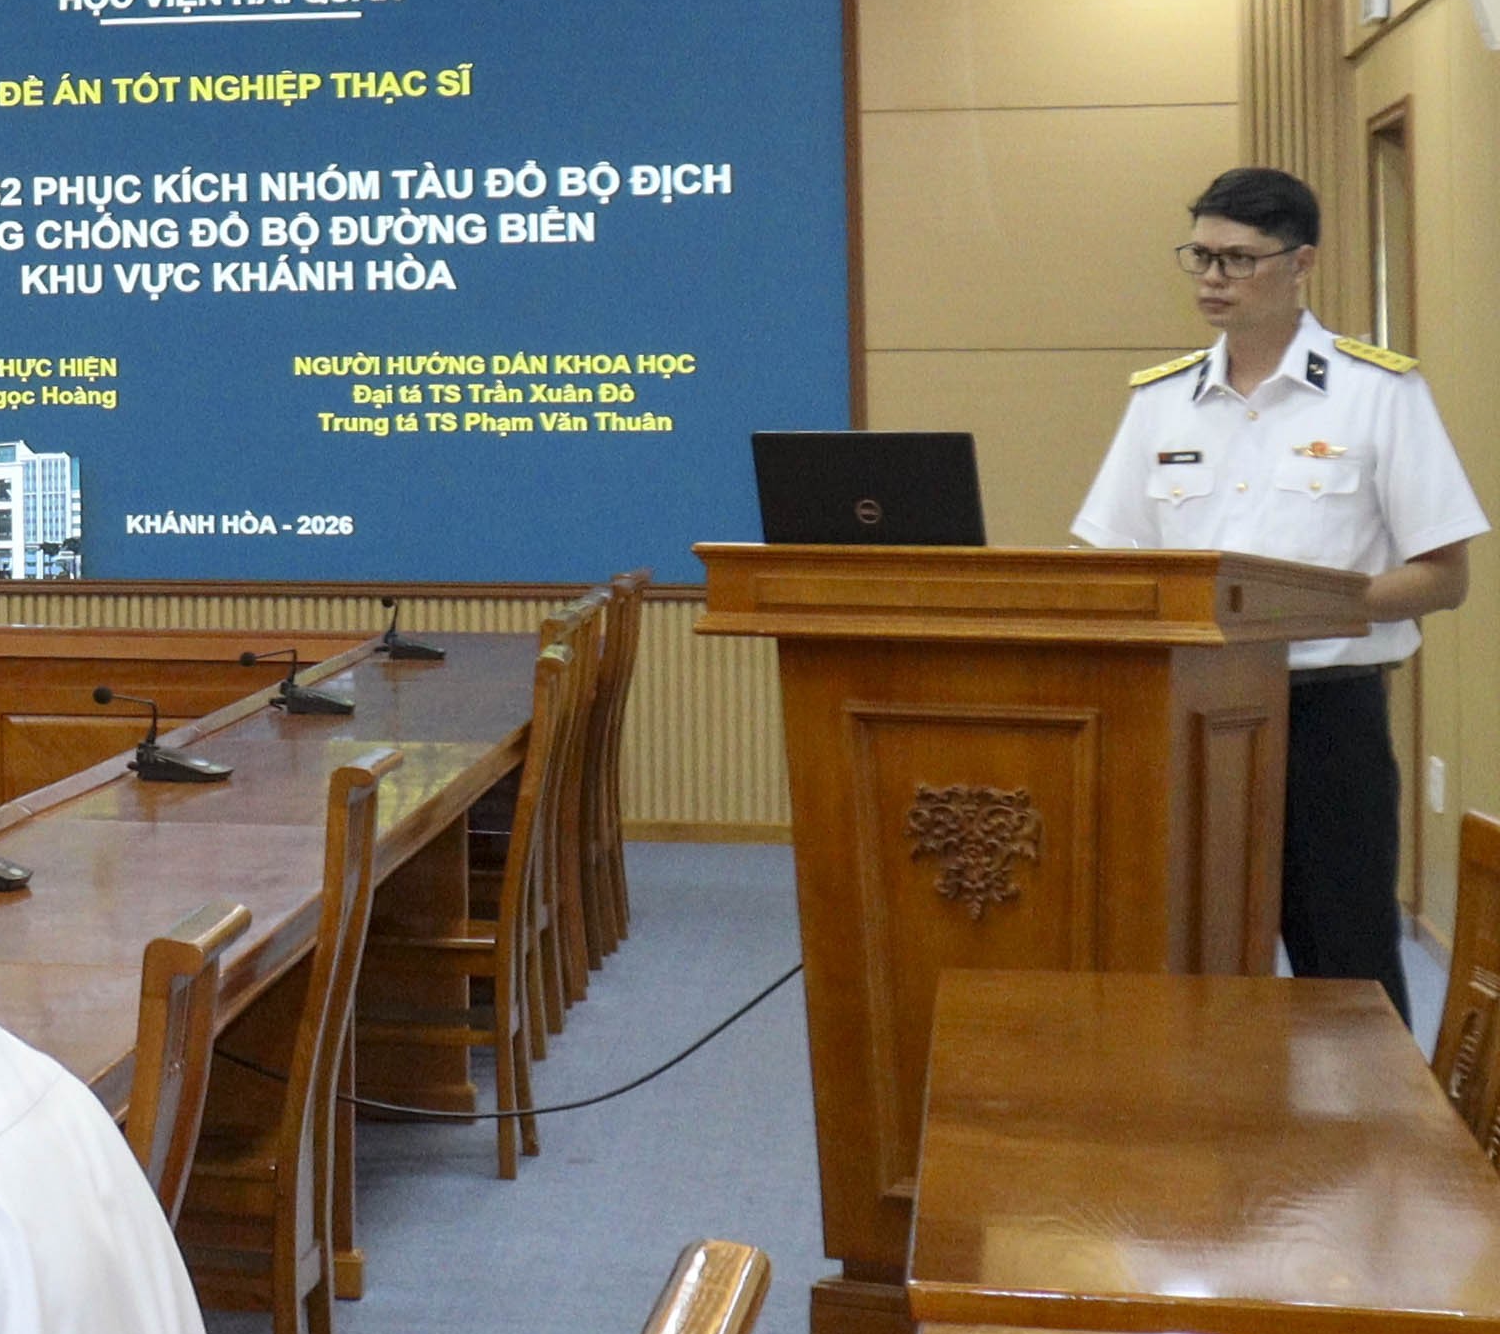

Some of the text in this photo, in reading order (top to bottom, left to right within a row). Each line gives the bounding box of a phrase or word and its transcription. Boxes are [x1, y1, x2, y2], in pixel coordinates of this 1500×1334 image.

[53, 73, 101, 105] ÁN
[112, 72, 180, 103] TỐT
[190, 71, 321, 106] NGHIỆP
[330, 71, 426, 104] THẠC
[437, 63, 472, 96] SĨ
[34, 175, 141, 213] PHỤC
[154, 167, 247, 203] KÍCH
[261, 164, 379, 201] NHÓM
[391, 162, 473, 199] TÀU
[559, 162, 620, 204] BỘ
[629, 164, 731, 203] ĐỊCH
[36, 213, 179, 249] CHỐNG
[262, 212, 319, 254] BỘ
[329, 208, 486, 246] ĐƯỜNG
[499, 206, 594, 243] BIỂN
[22, 253, 456, 300] KHU VỰC KHÁNH HÒA
[60, 356, 116, 382] HIỆN
[295, 352, 380, 375] NGƯỜI
[387, 352, 485, 375] HƯỚNG
[555, 355, 631, 374] KHOA
[637, 354, 695, 378] HỌC
[42, 386, 116, 409] Hoàng
[353, 384, 393, 408] Đại
[399, 385, 422, 403] tá
[428, 384, 461, 403] TS
[529, 384, 592, 403] Xuân
[318, 413, 389, 436] Trung
[395, 413, 418, 431] tá
[425, 413, 457, 431] TS
[464, 412, 533, 436] Phạm
[539, 412, 587, 431] Văn
[127, 510, 214, 534] KHÁNH
[222, 511, 277, 534] HÒA
[297, 515, 353, 535] 2026
